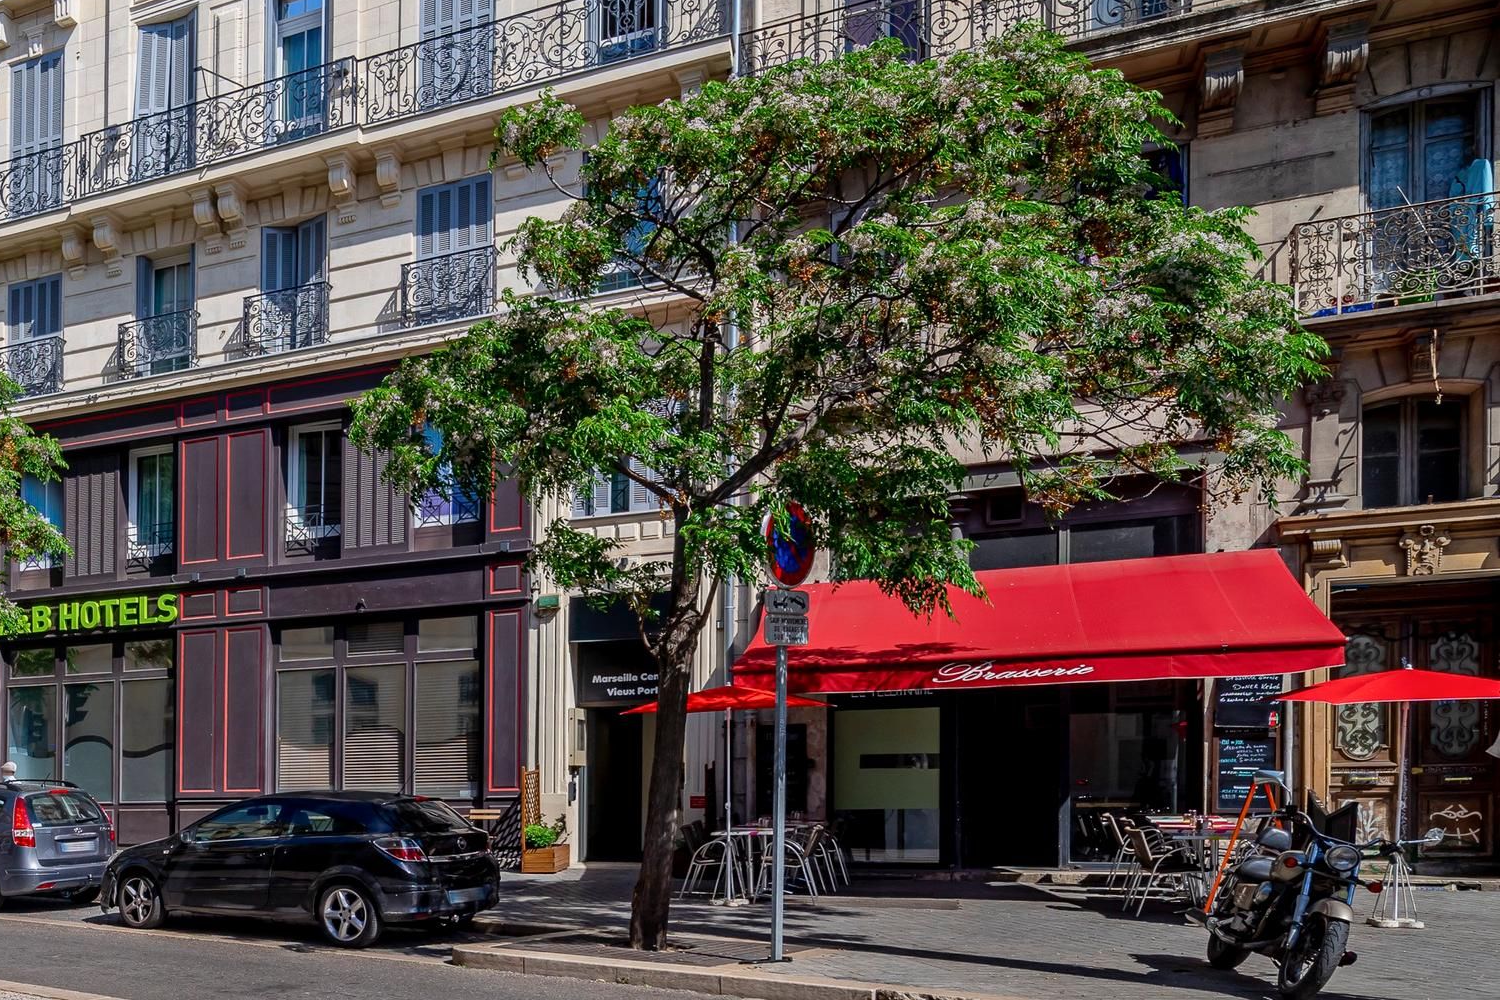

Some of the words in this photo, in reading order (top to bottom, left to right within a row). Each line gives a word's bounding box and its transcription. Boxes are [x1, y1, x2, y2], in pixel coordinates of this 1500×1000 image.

[59, 594, 178, 631] HOTELS
[592, 672, 638, 684] Marseille
[932, 660, 1094, 683] Brasserie
[606, 687, 636, 697] Vieux
